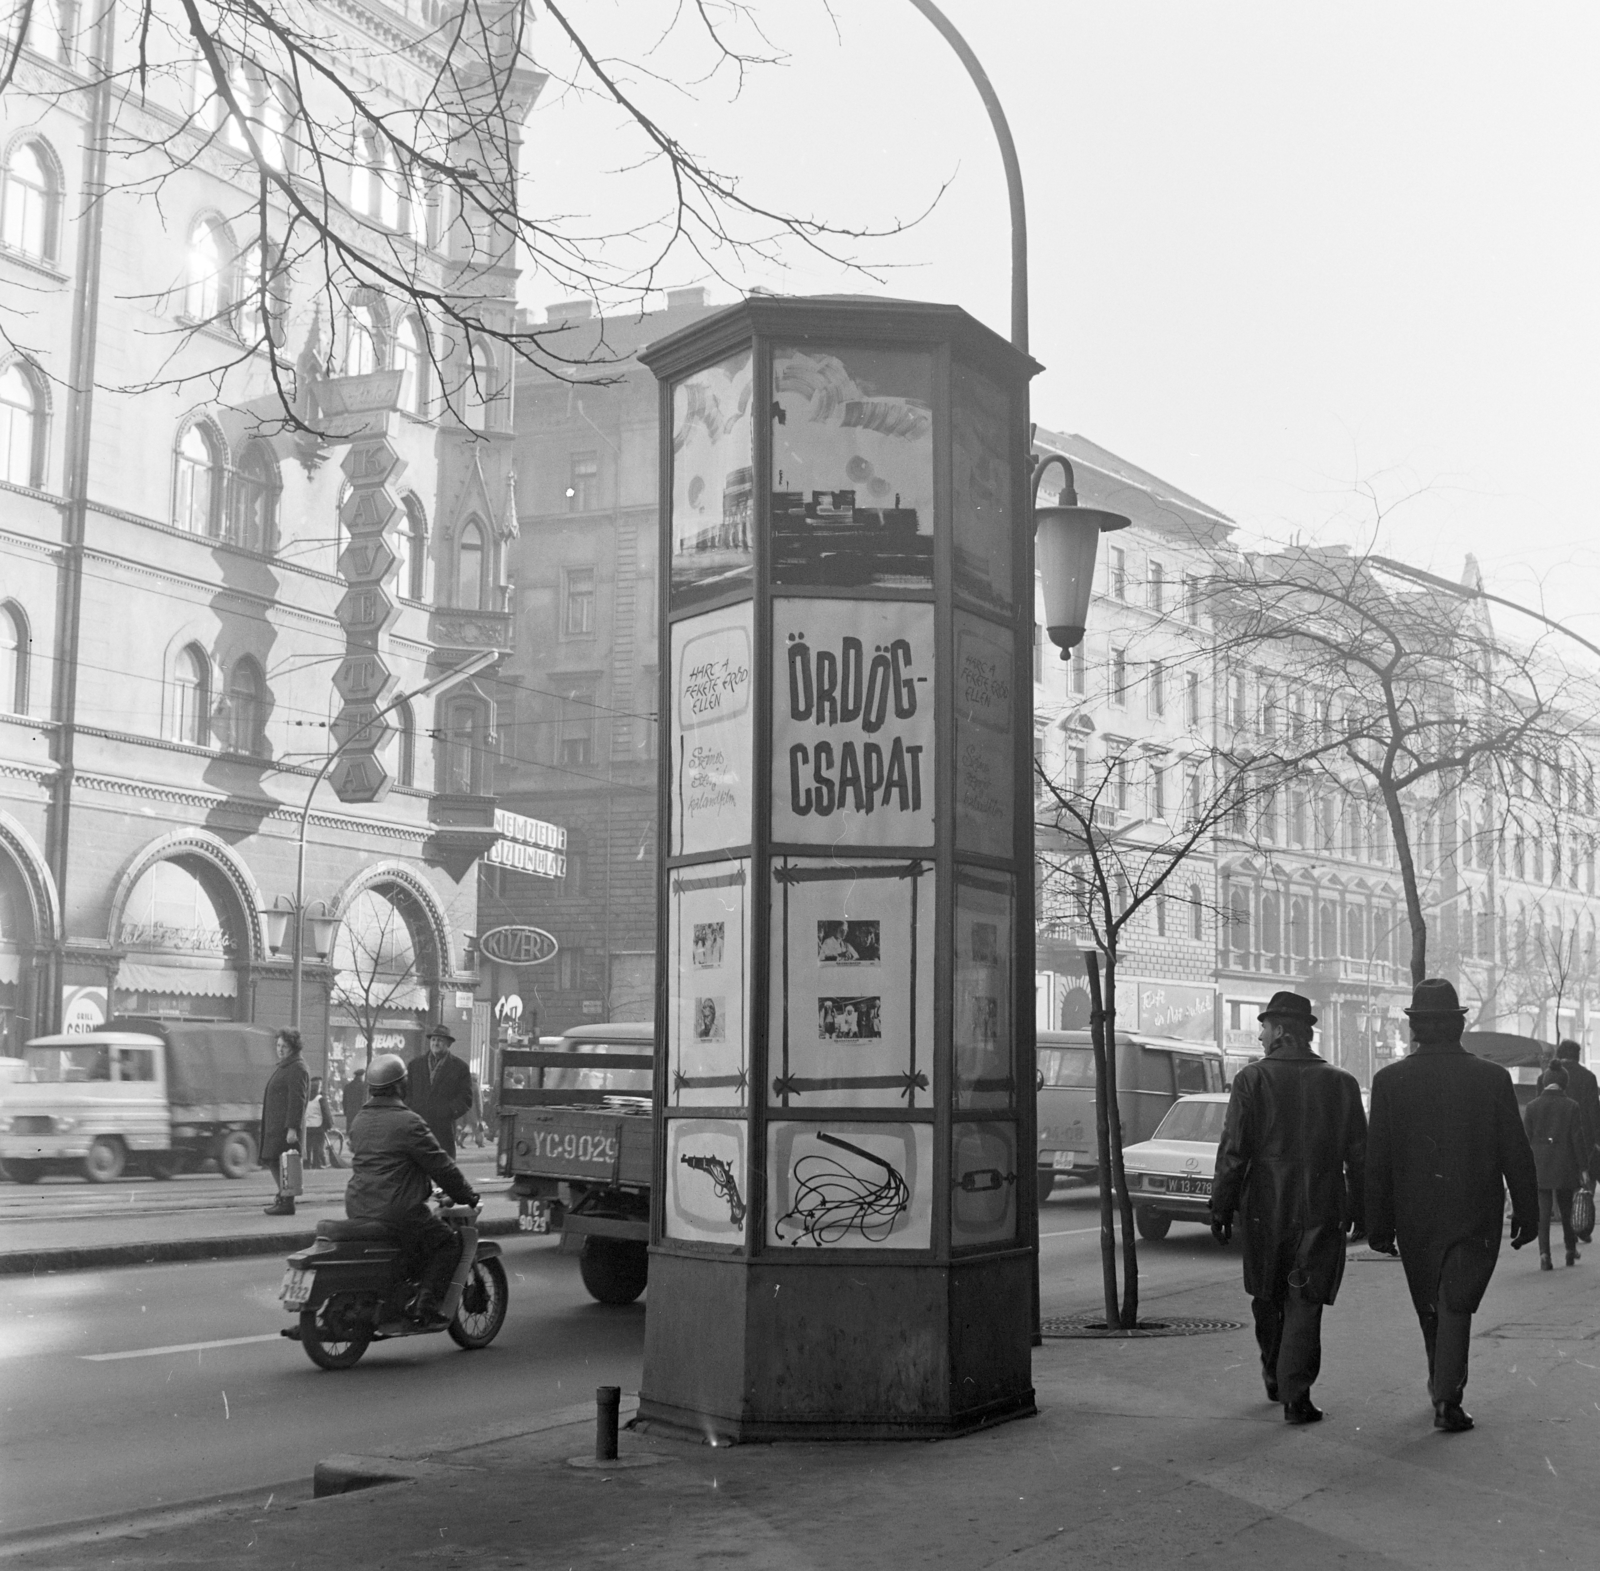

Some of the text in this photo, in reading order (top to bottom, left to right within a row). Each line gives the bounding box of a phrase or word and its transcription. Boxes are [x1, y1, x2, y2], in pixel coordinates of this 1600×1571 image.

[689, 658, 730, 682] HARC A
[965, 655, 996, 677] HARC A
[684, 676, 721, 699] FEKETE
[787, 631, 928, 734] ÖRDÖG-
[960, 667, 989, 691] FEKETE
[692, 692, 722, 715] ELLEN
[965, 686, 991, 707] ELLEN
[789, 736, 923, 817] CSAPAT
[495, 813, 566, 849] NEMZETI
[1168, 1179, 1178, 1191] W
[527, 1200, 541, 1216] YC
